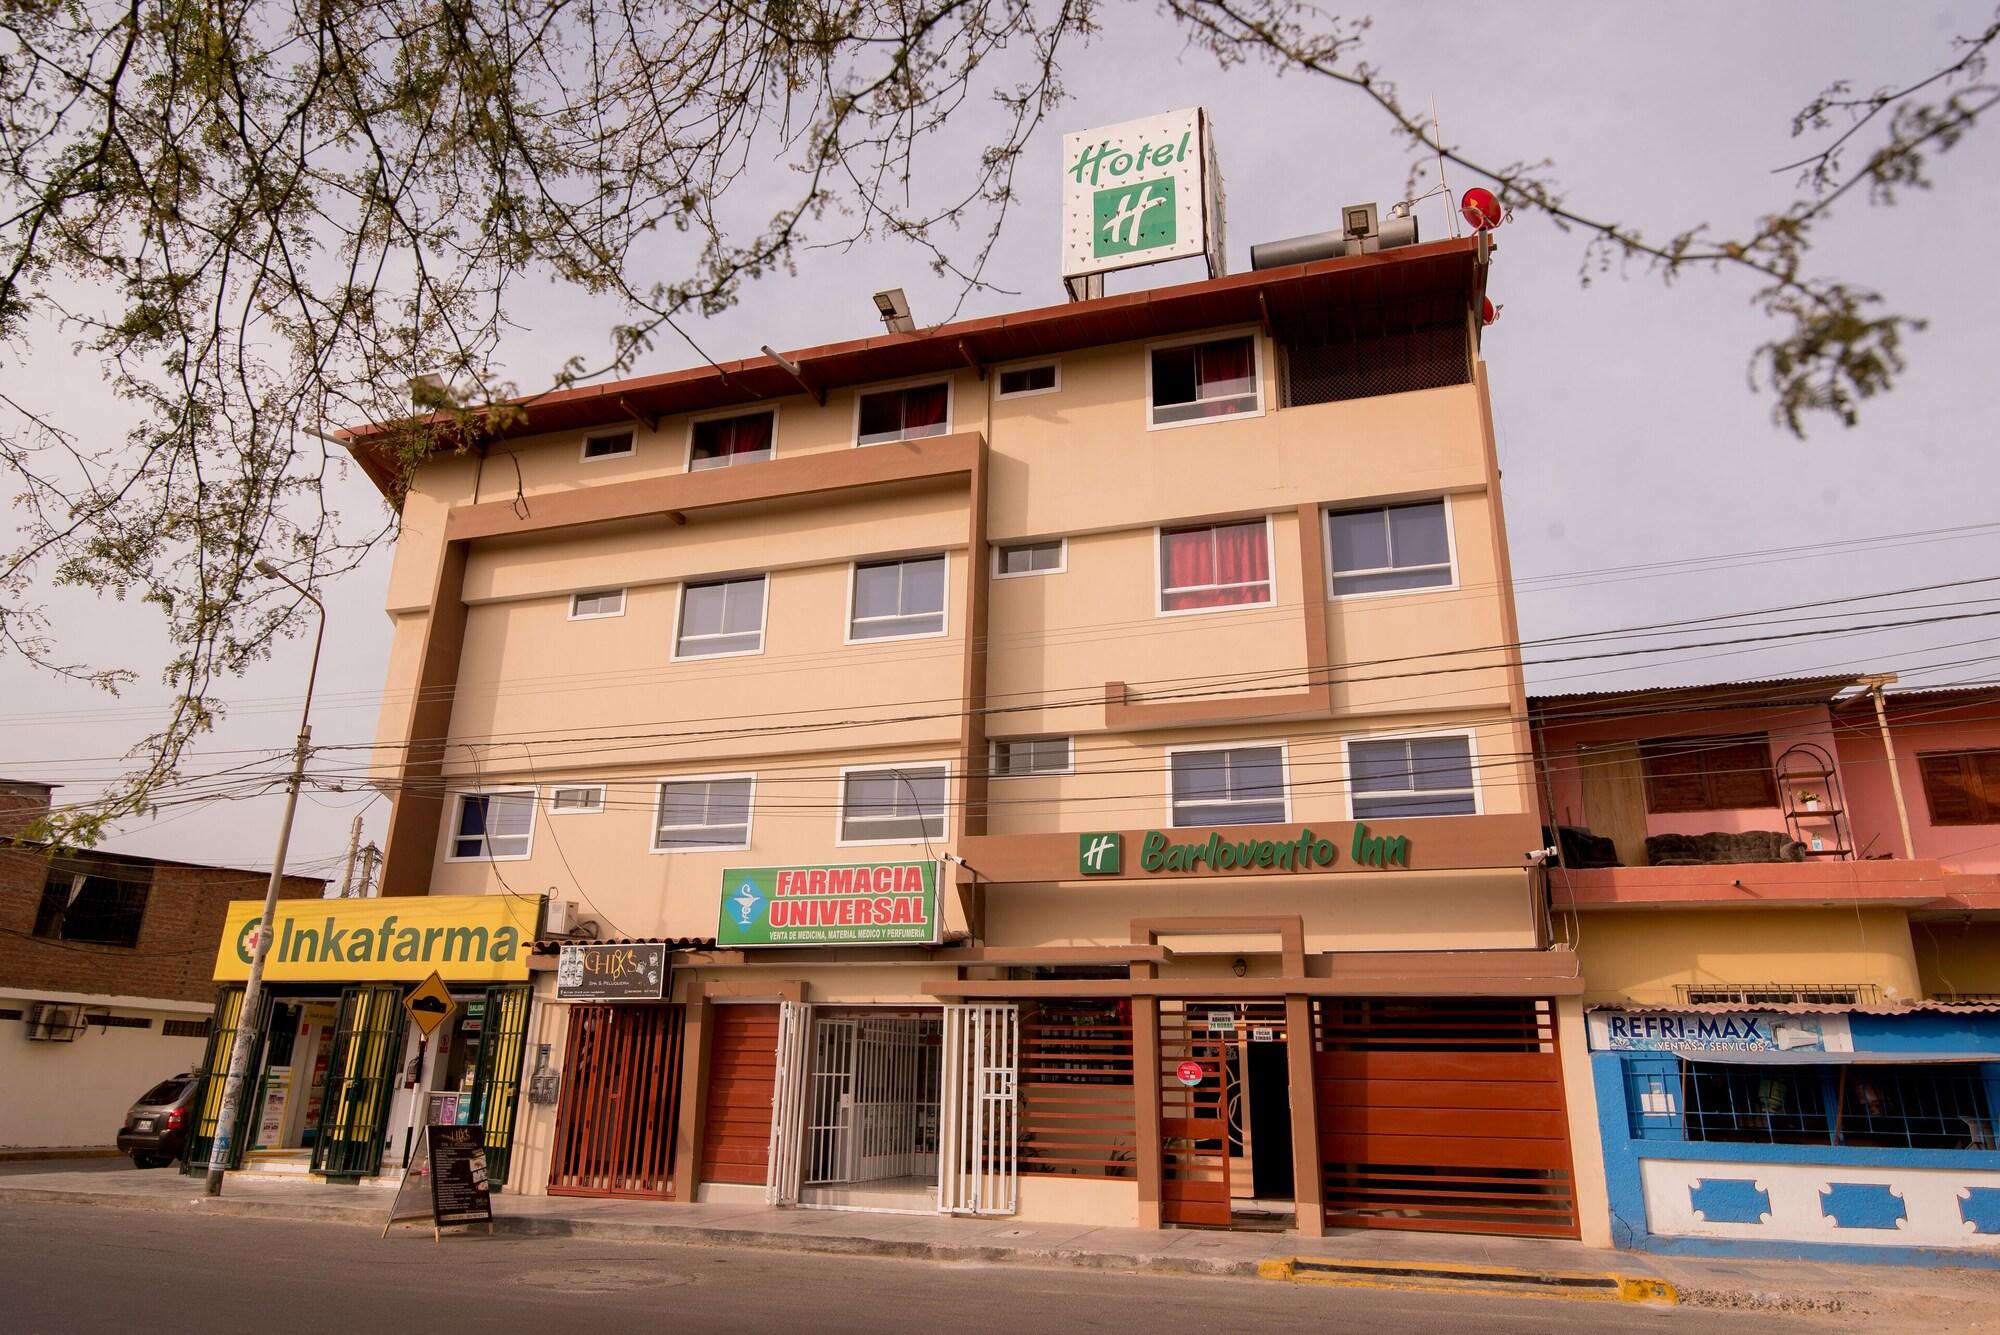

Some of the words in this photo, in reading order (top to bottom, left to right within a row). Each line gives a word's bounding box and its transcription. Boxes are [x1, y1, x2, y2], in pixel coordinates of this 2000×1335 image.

[1068, 131, 1191, 186] Hotel
[1140, 828, 1335, 873] Barlovento
[1351, 822, 1406, 868] Inn
[776, 866, 924, 896] FARMACIA
[769, 897, 928, 927] UNIVERSAL
[277, 915, 519, 963] Inkafarma
[769, 931, 788, 940] VENTA
[789, 931, 797, 940] DE
[828, 929, 856, 939] MATERIAL
[858, 929, 880, 938] MEDICO
[881, 929, 887, 938] Y
[1610, 1016, 1765, 1040] REFRI-MAX
[1657, 1041, 1698, 1051] VENTAS
[1710, 1041, 1766, 1051] SERVICIOS
